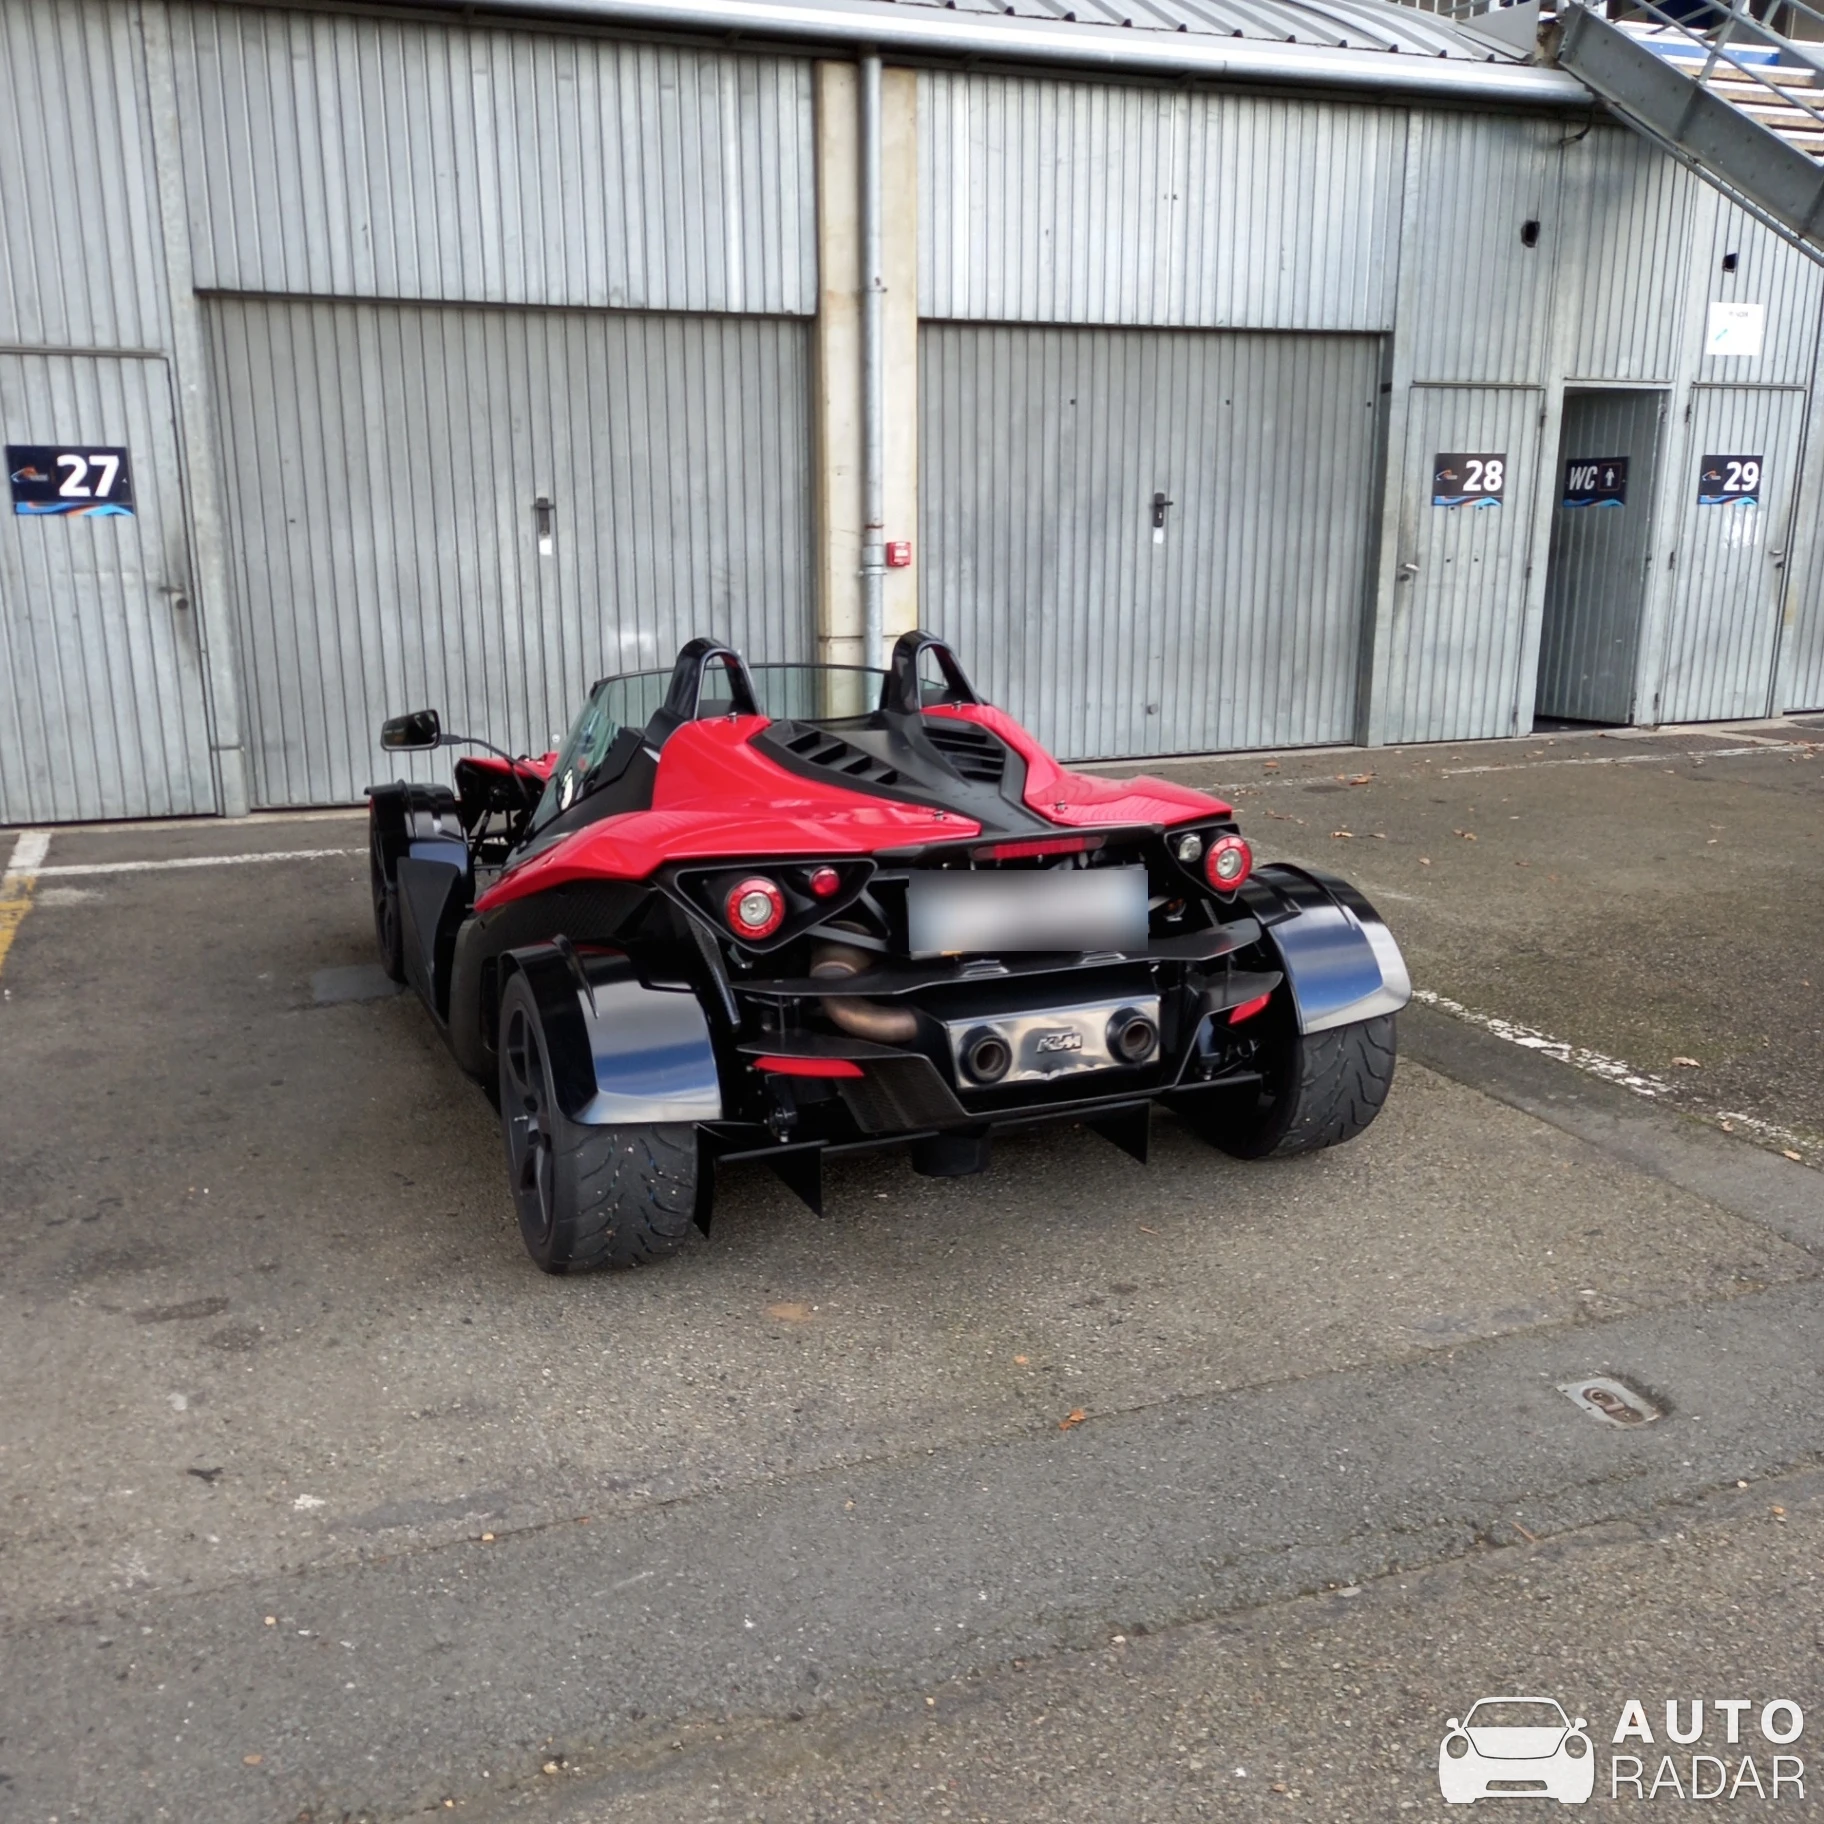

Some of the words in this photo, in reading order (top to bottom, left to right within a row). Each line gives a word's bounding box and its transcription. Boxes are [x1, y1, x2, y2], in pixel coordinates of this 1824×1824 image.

[56, 454, 120, 497] 27
[1462, 459, 1504, 492] 28
[1568, 465, 1598, 491] WC
[1723, 461, 1760, 492] 29
[1037, 1033, 1082, 1053] KTM
